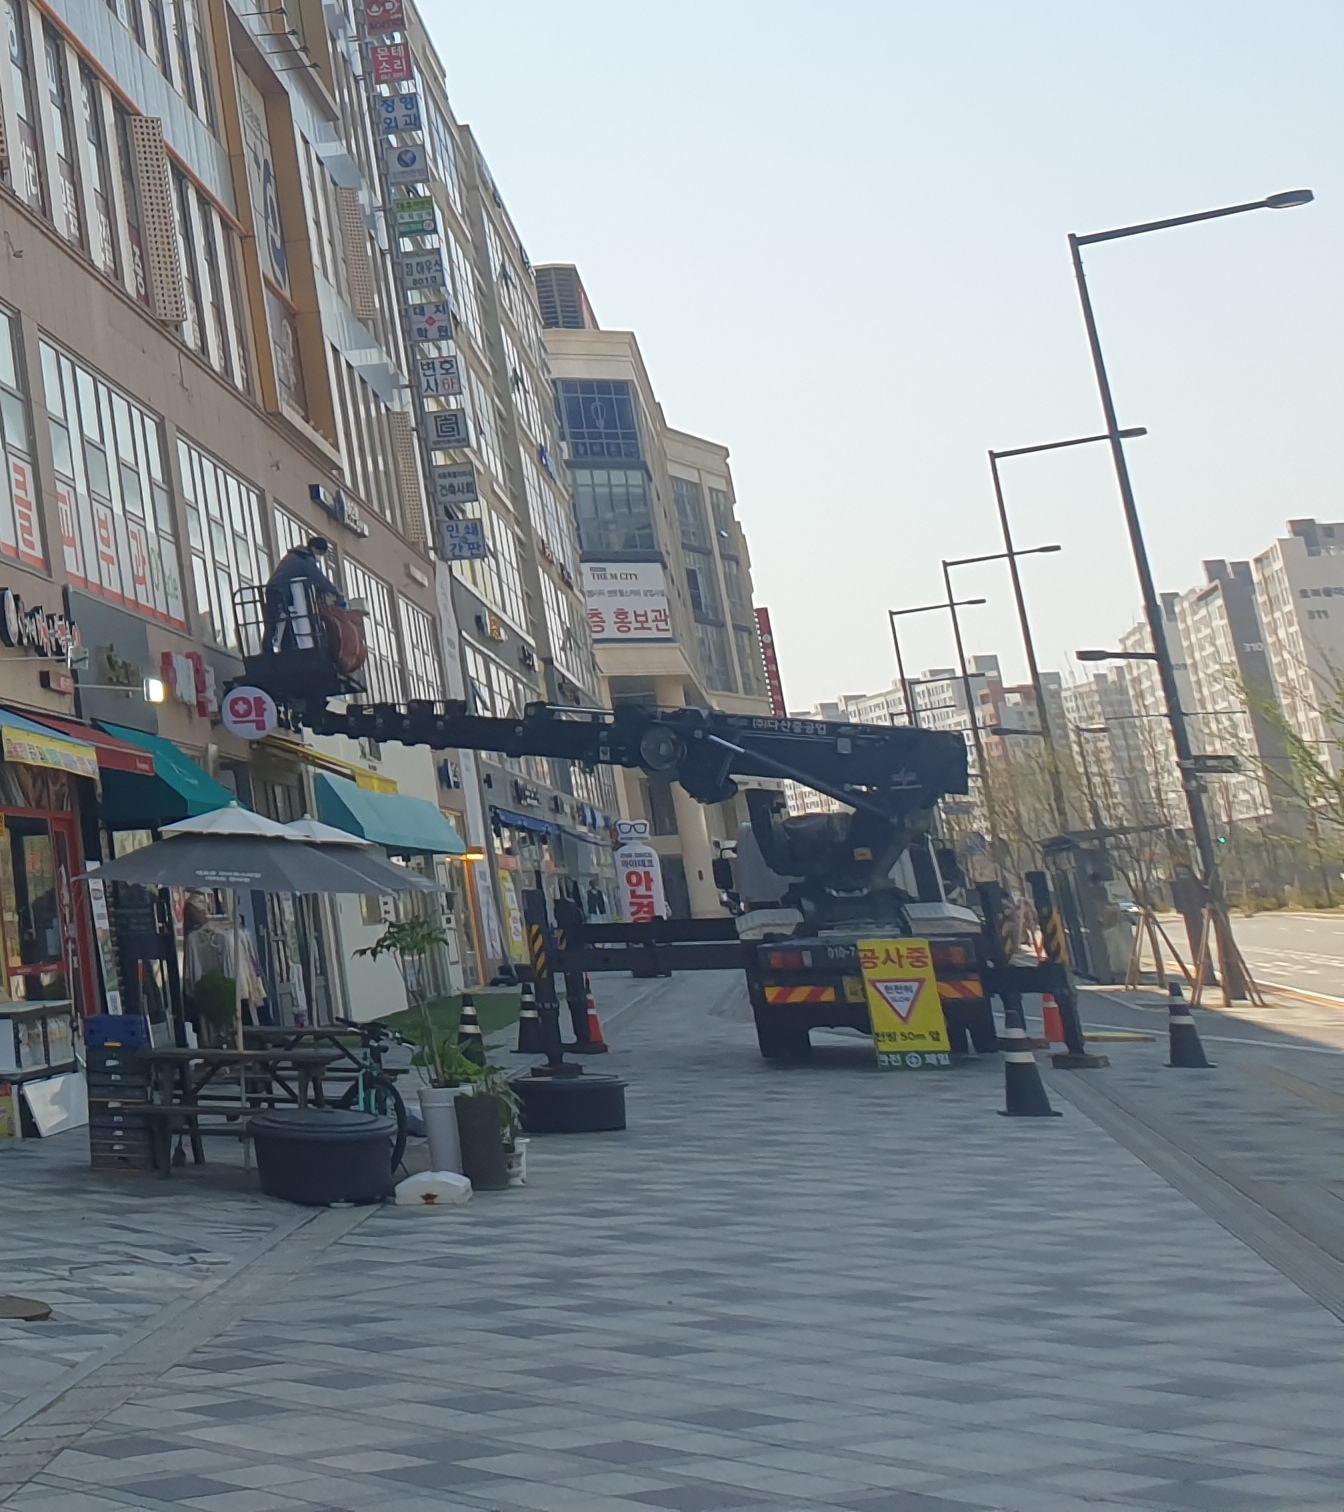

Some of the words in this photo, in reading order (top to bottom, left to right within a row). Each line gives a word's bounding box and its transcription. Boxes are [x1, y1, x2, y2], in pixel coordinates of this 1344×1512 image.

[375, 44, 404, 60] 몬테
[378, 58, 406, 75] 소리
[384, 113, 418, 130] 외과
[420, 359, 456, 377] 변호
[438, 479, 475, 497] 건축사회
[446, 522, 479, 538] 인쇄
[619, 572, 639, 581] CITY
[613, 607, 671, 634] 홍보관
[229, 696, 267, 732] 약
[858, 947, 929, 970] 공사중
[899, 1032, 927, 1043] 50m
